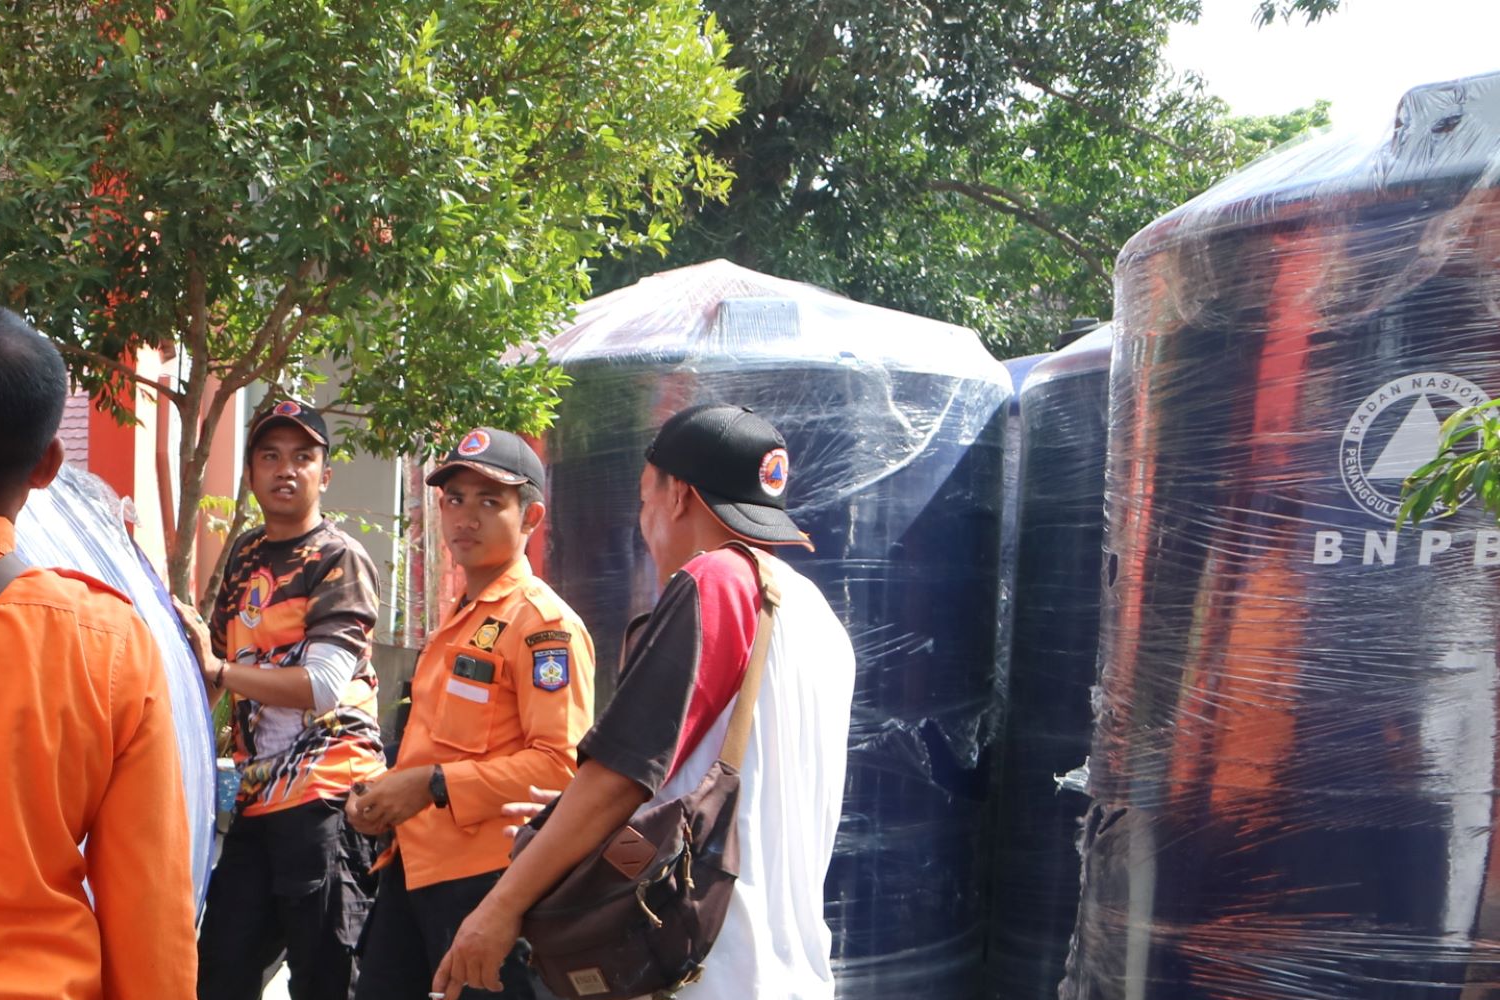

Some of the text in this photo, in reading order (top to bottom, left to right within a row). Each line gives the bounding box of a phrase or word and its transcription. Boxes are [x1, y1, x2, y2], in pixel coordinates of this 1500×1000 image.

[1350, 377, 1489, 435] BADAN NASION
[1313, 530, 1500, 566] BNPB
